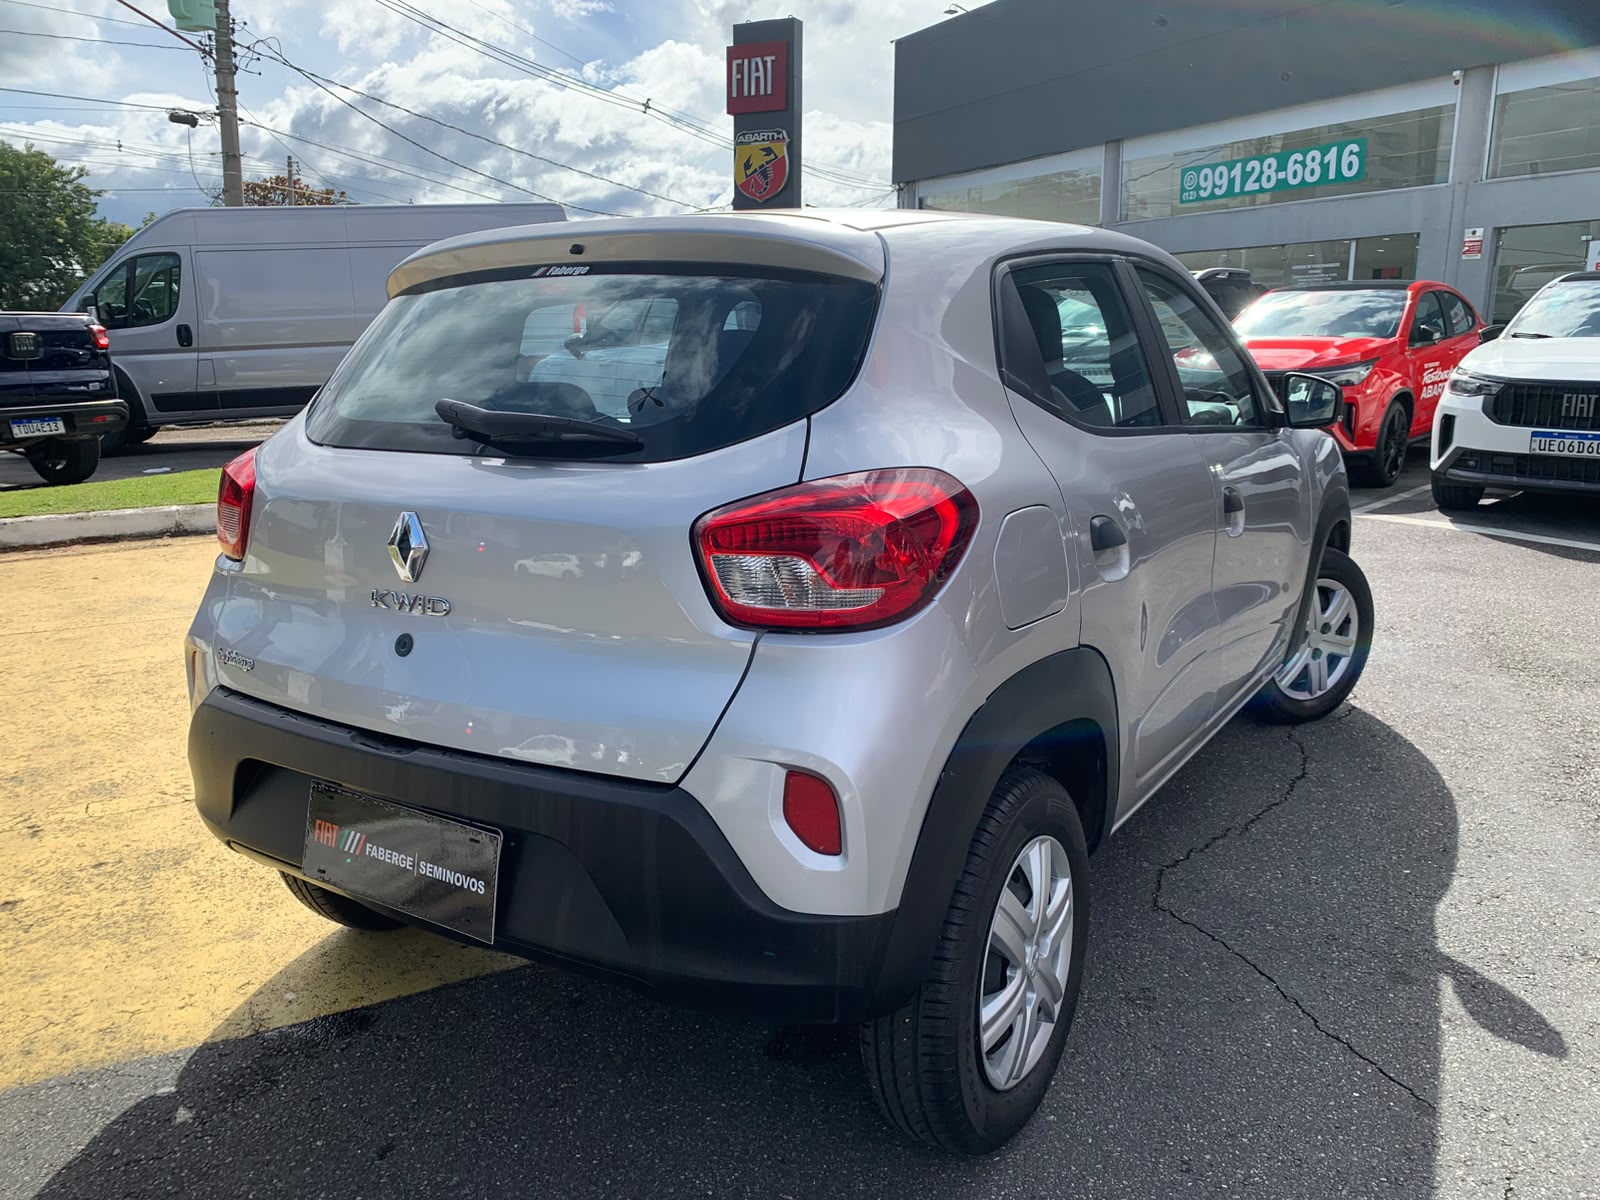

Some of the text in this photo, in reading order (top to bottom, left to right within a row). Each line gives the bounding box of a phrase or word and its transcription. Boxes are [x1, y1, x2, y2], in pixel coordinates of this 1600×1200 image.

[731, 56, 775, 97] FIAT
[738, 133, 783, 142] ABARTH
[1182, 143, 1360, 200] (12) 99128-6816
[546, 266, 590, 275] Faberge
[1561, 393, 1599, 417] FIAT
[370, 588, 451, 616] KWID
[314, 819, 339, 848] FIAT
[365, 843, 485, 895] FABERGE SEMINOVOS
